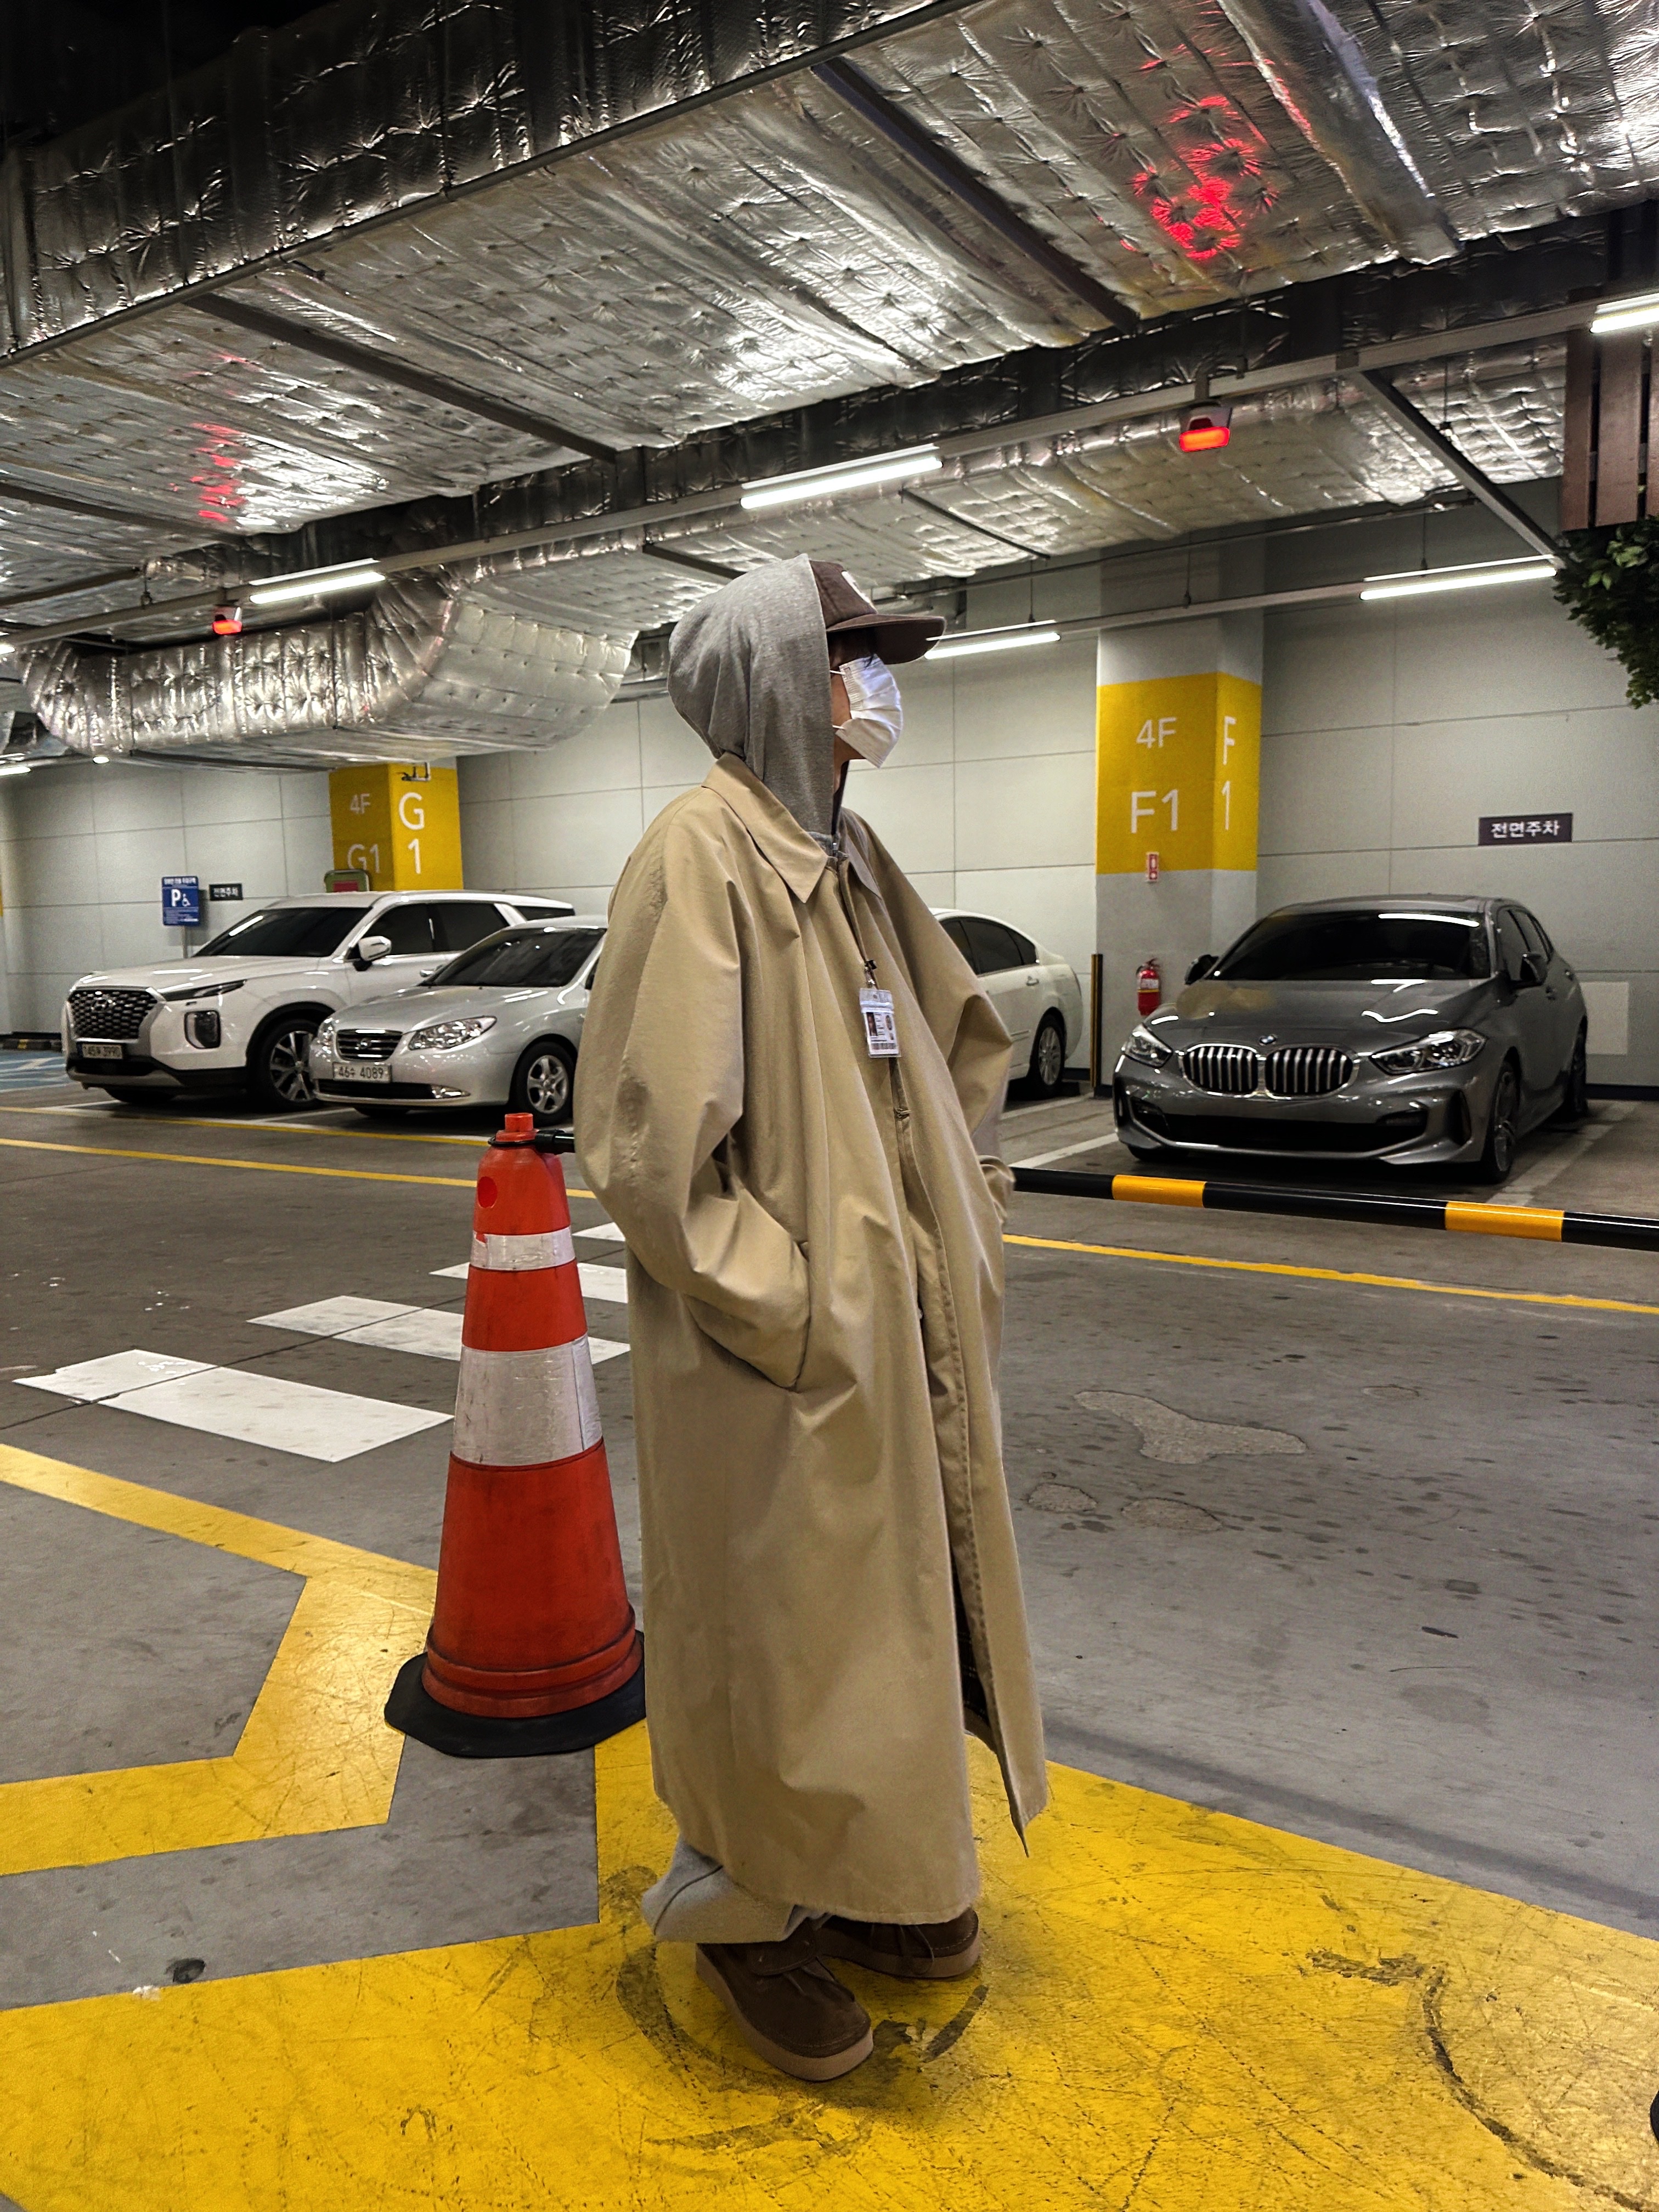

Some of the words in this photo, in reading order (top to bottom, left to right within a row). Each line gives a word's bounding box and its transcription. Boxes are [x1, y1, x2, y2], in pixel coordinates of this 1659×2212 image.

[1136, 716, 1177, 749] 4F
[1222, 715, 1237, 766] F
[349, 793, 370, 815] 4F
[398, 792, 425, 831] G
[1130, 788, 1179, 834] F1
[1221, 780, 1231, 831] 1
[1490, 819, 1561, 839] 전면주차
[347, 843, 381, 874] G1
[408, 838, 421, 874] 1
[171, 888, 182, 907] P
[360, 1066, 384, 1079] 4089
